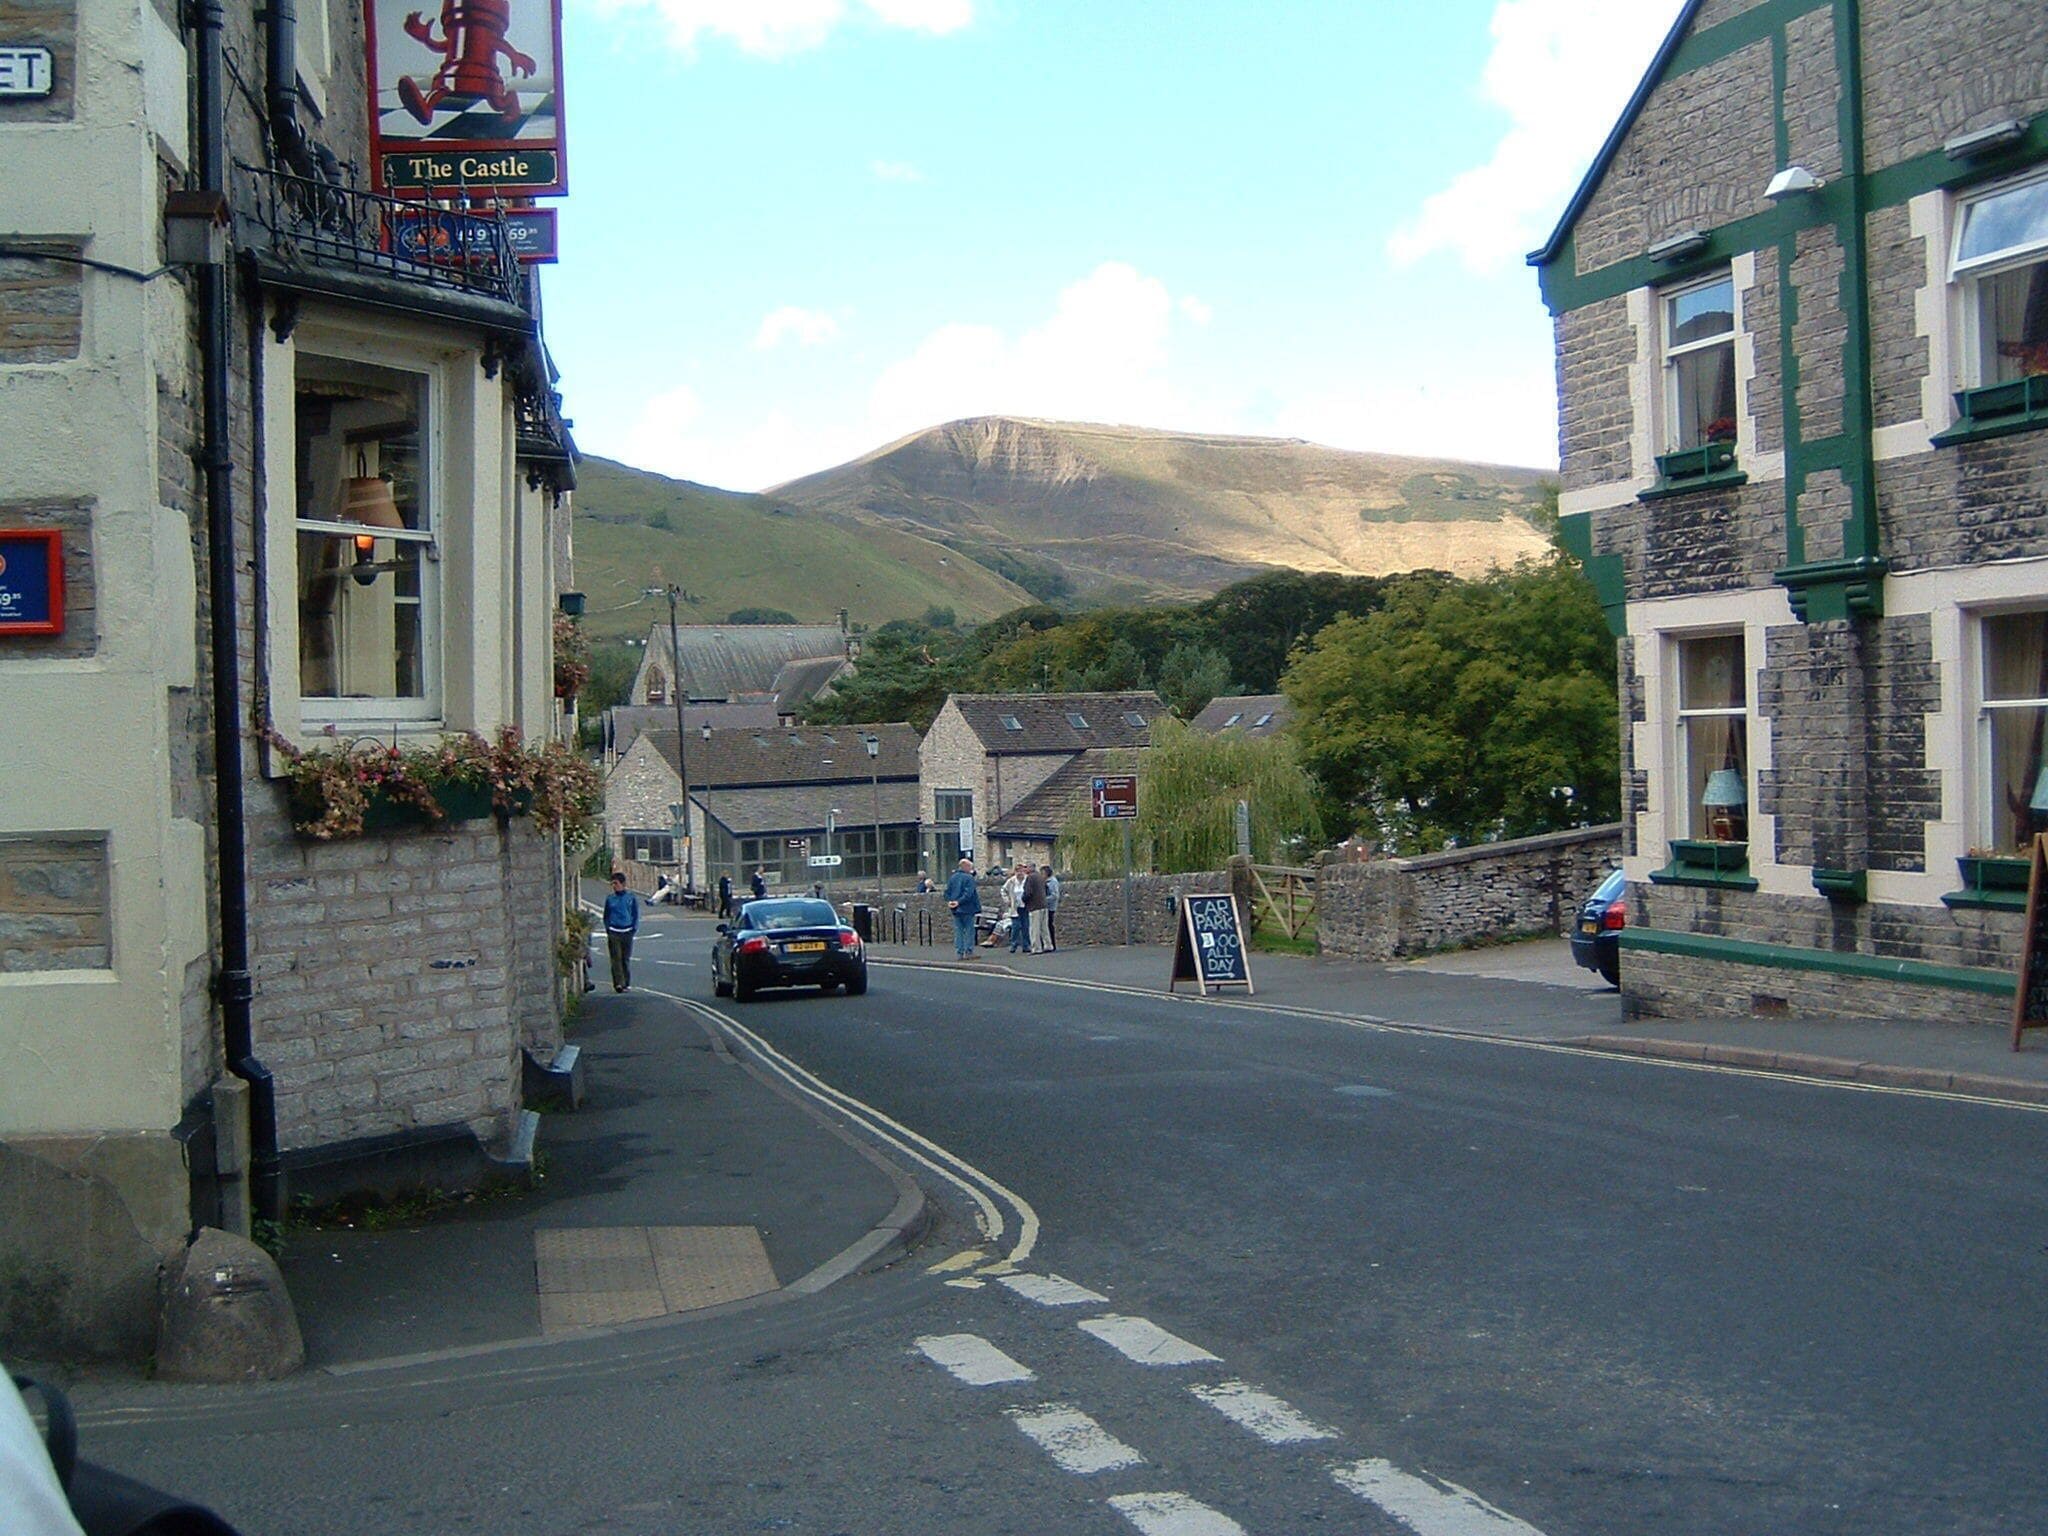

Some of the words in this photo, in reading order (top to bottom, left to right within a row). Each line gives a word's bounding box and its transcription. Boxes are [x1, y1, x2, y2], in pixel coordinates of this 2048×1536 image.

[409, 158, 452, 178] The
[460, 156, 528, 177] Castle
[1193, 900, 1229, 916] CAR
[1195, 914, 1233, 930] PARK
[1207, 947, 1232, 959] ALL
[1208, 959, 1235, 971] DAY
